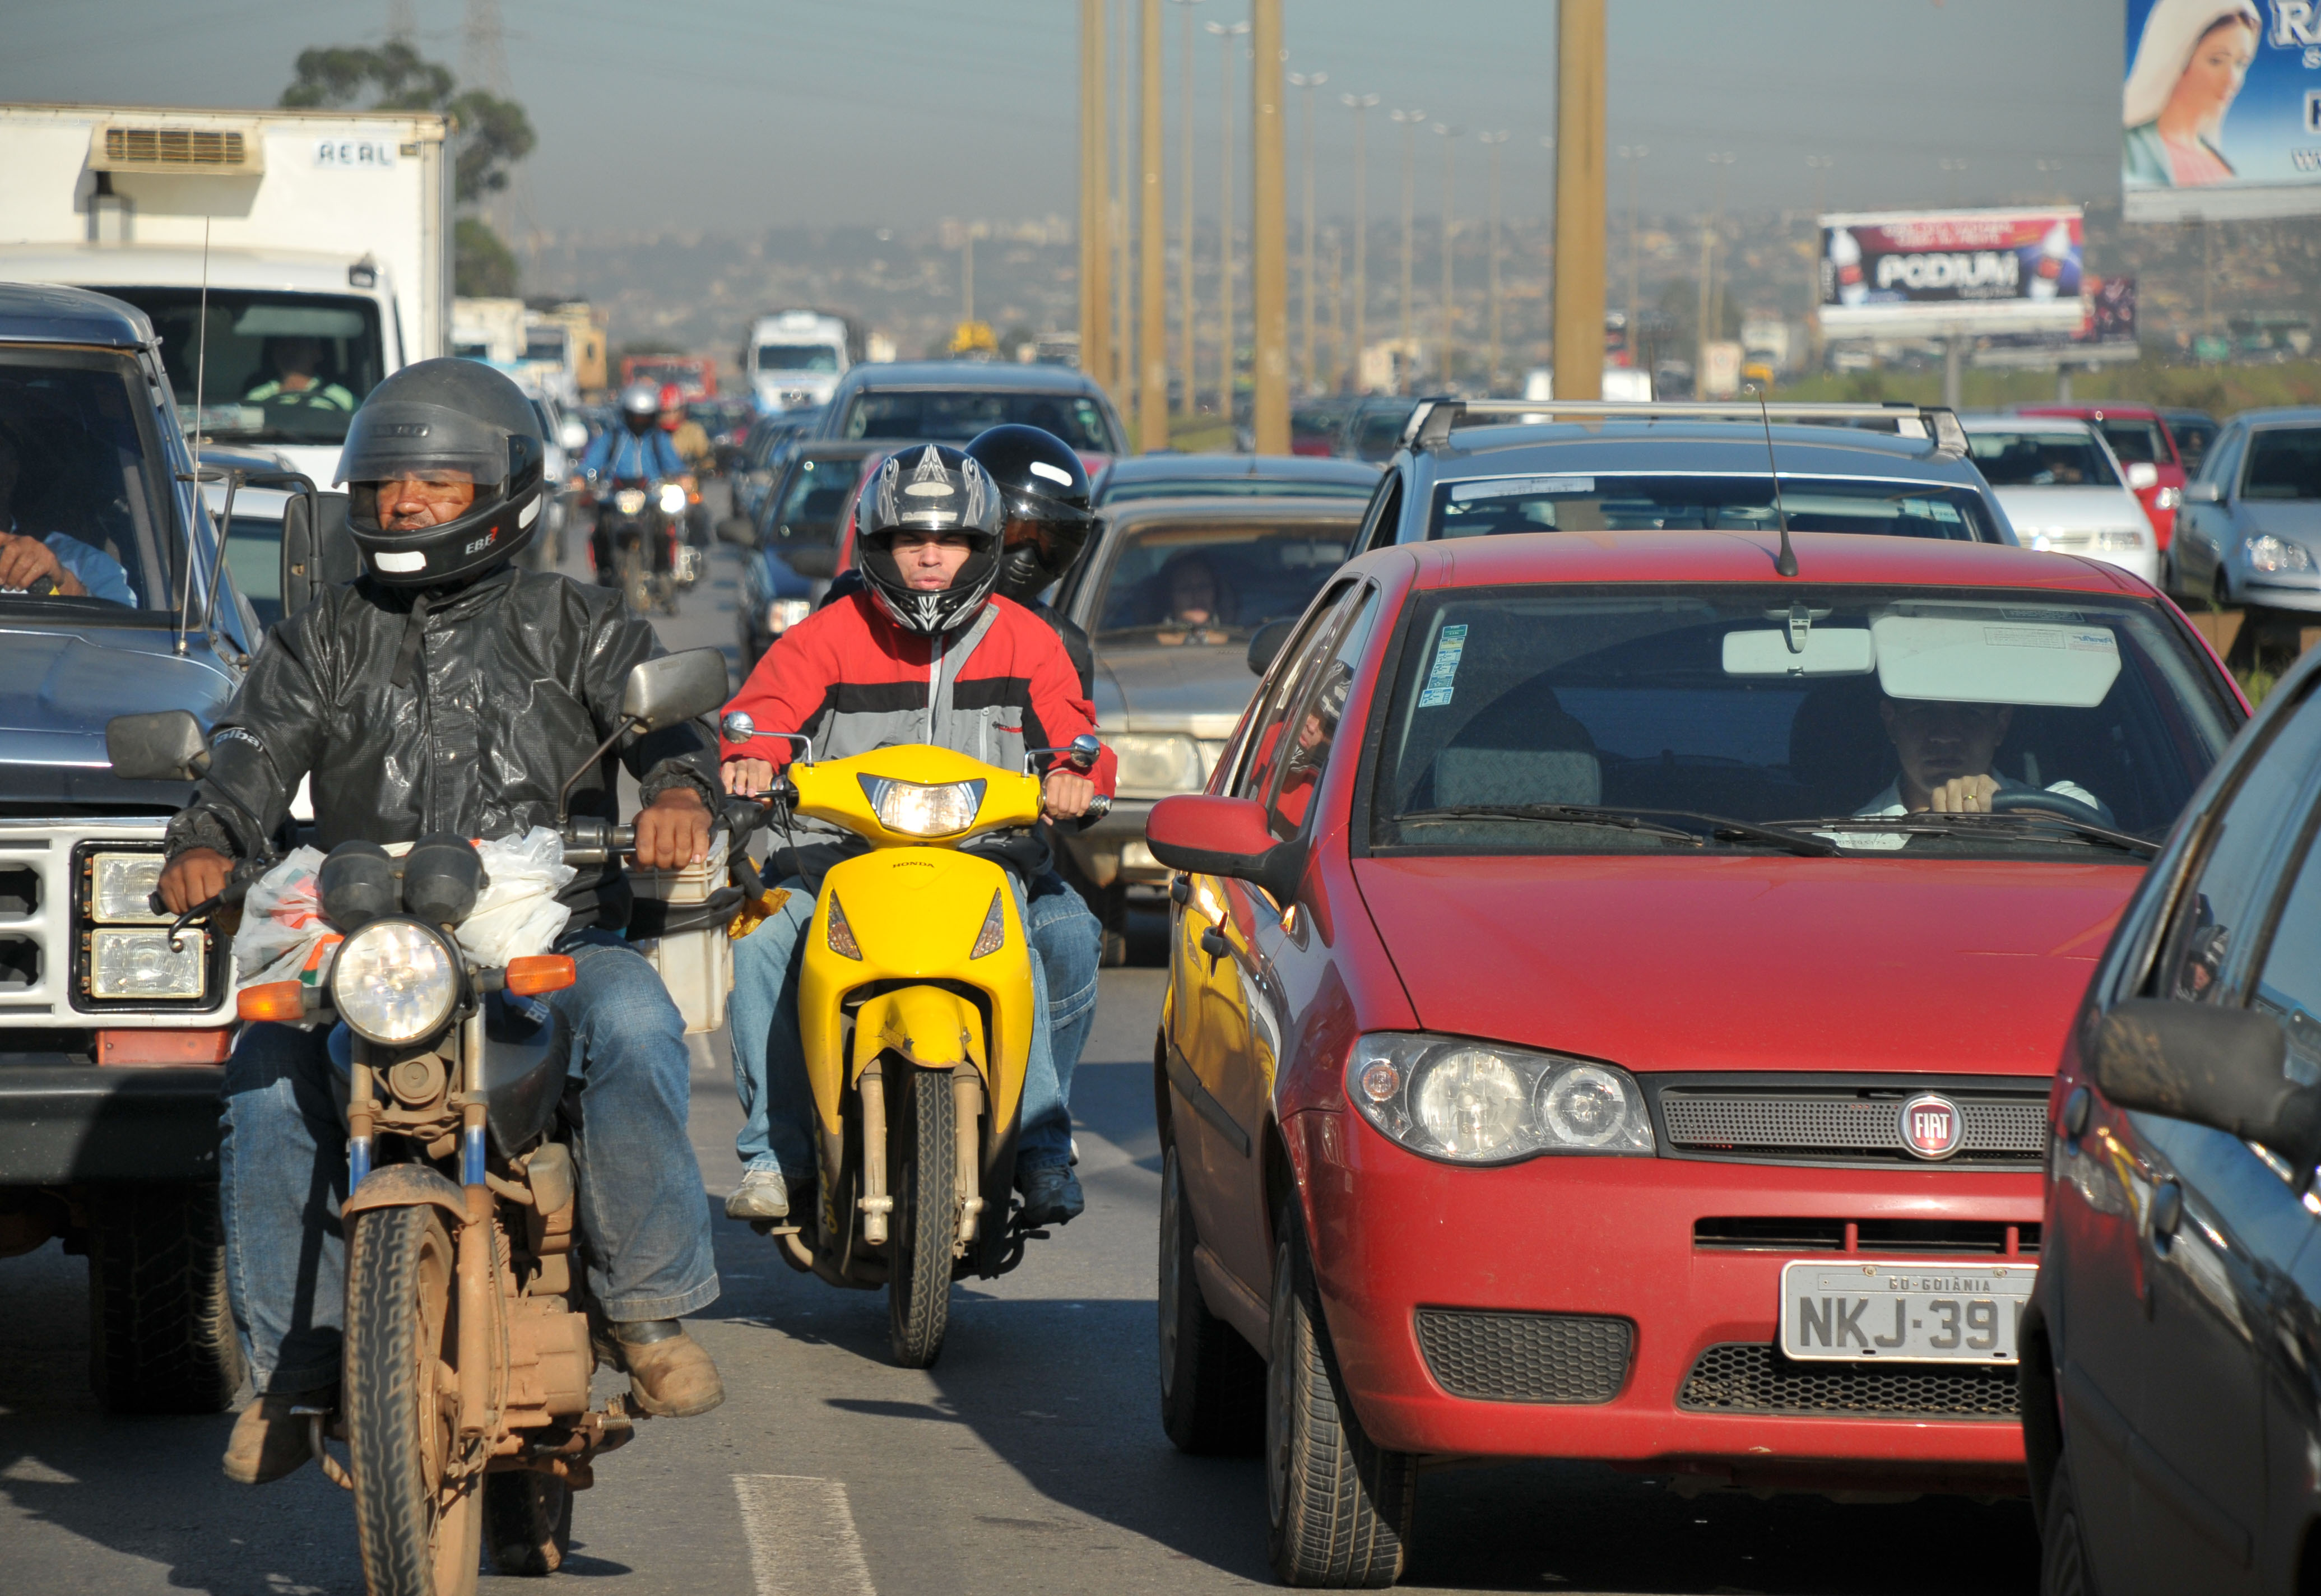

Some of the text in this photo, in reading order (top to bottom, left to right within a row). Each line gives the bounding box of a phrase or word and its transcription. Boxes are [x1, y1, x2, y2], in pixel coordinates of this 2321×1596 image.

[2268, 0, 2321, 49] R
[1877, 251, 2018, 289] PODIUM
[1914, 1113, 1950, 1139] FIAT
